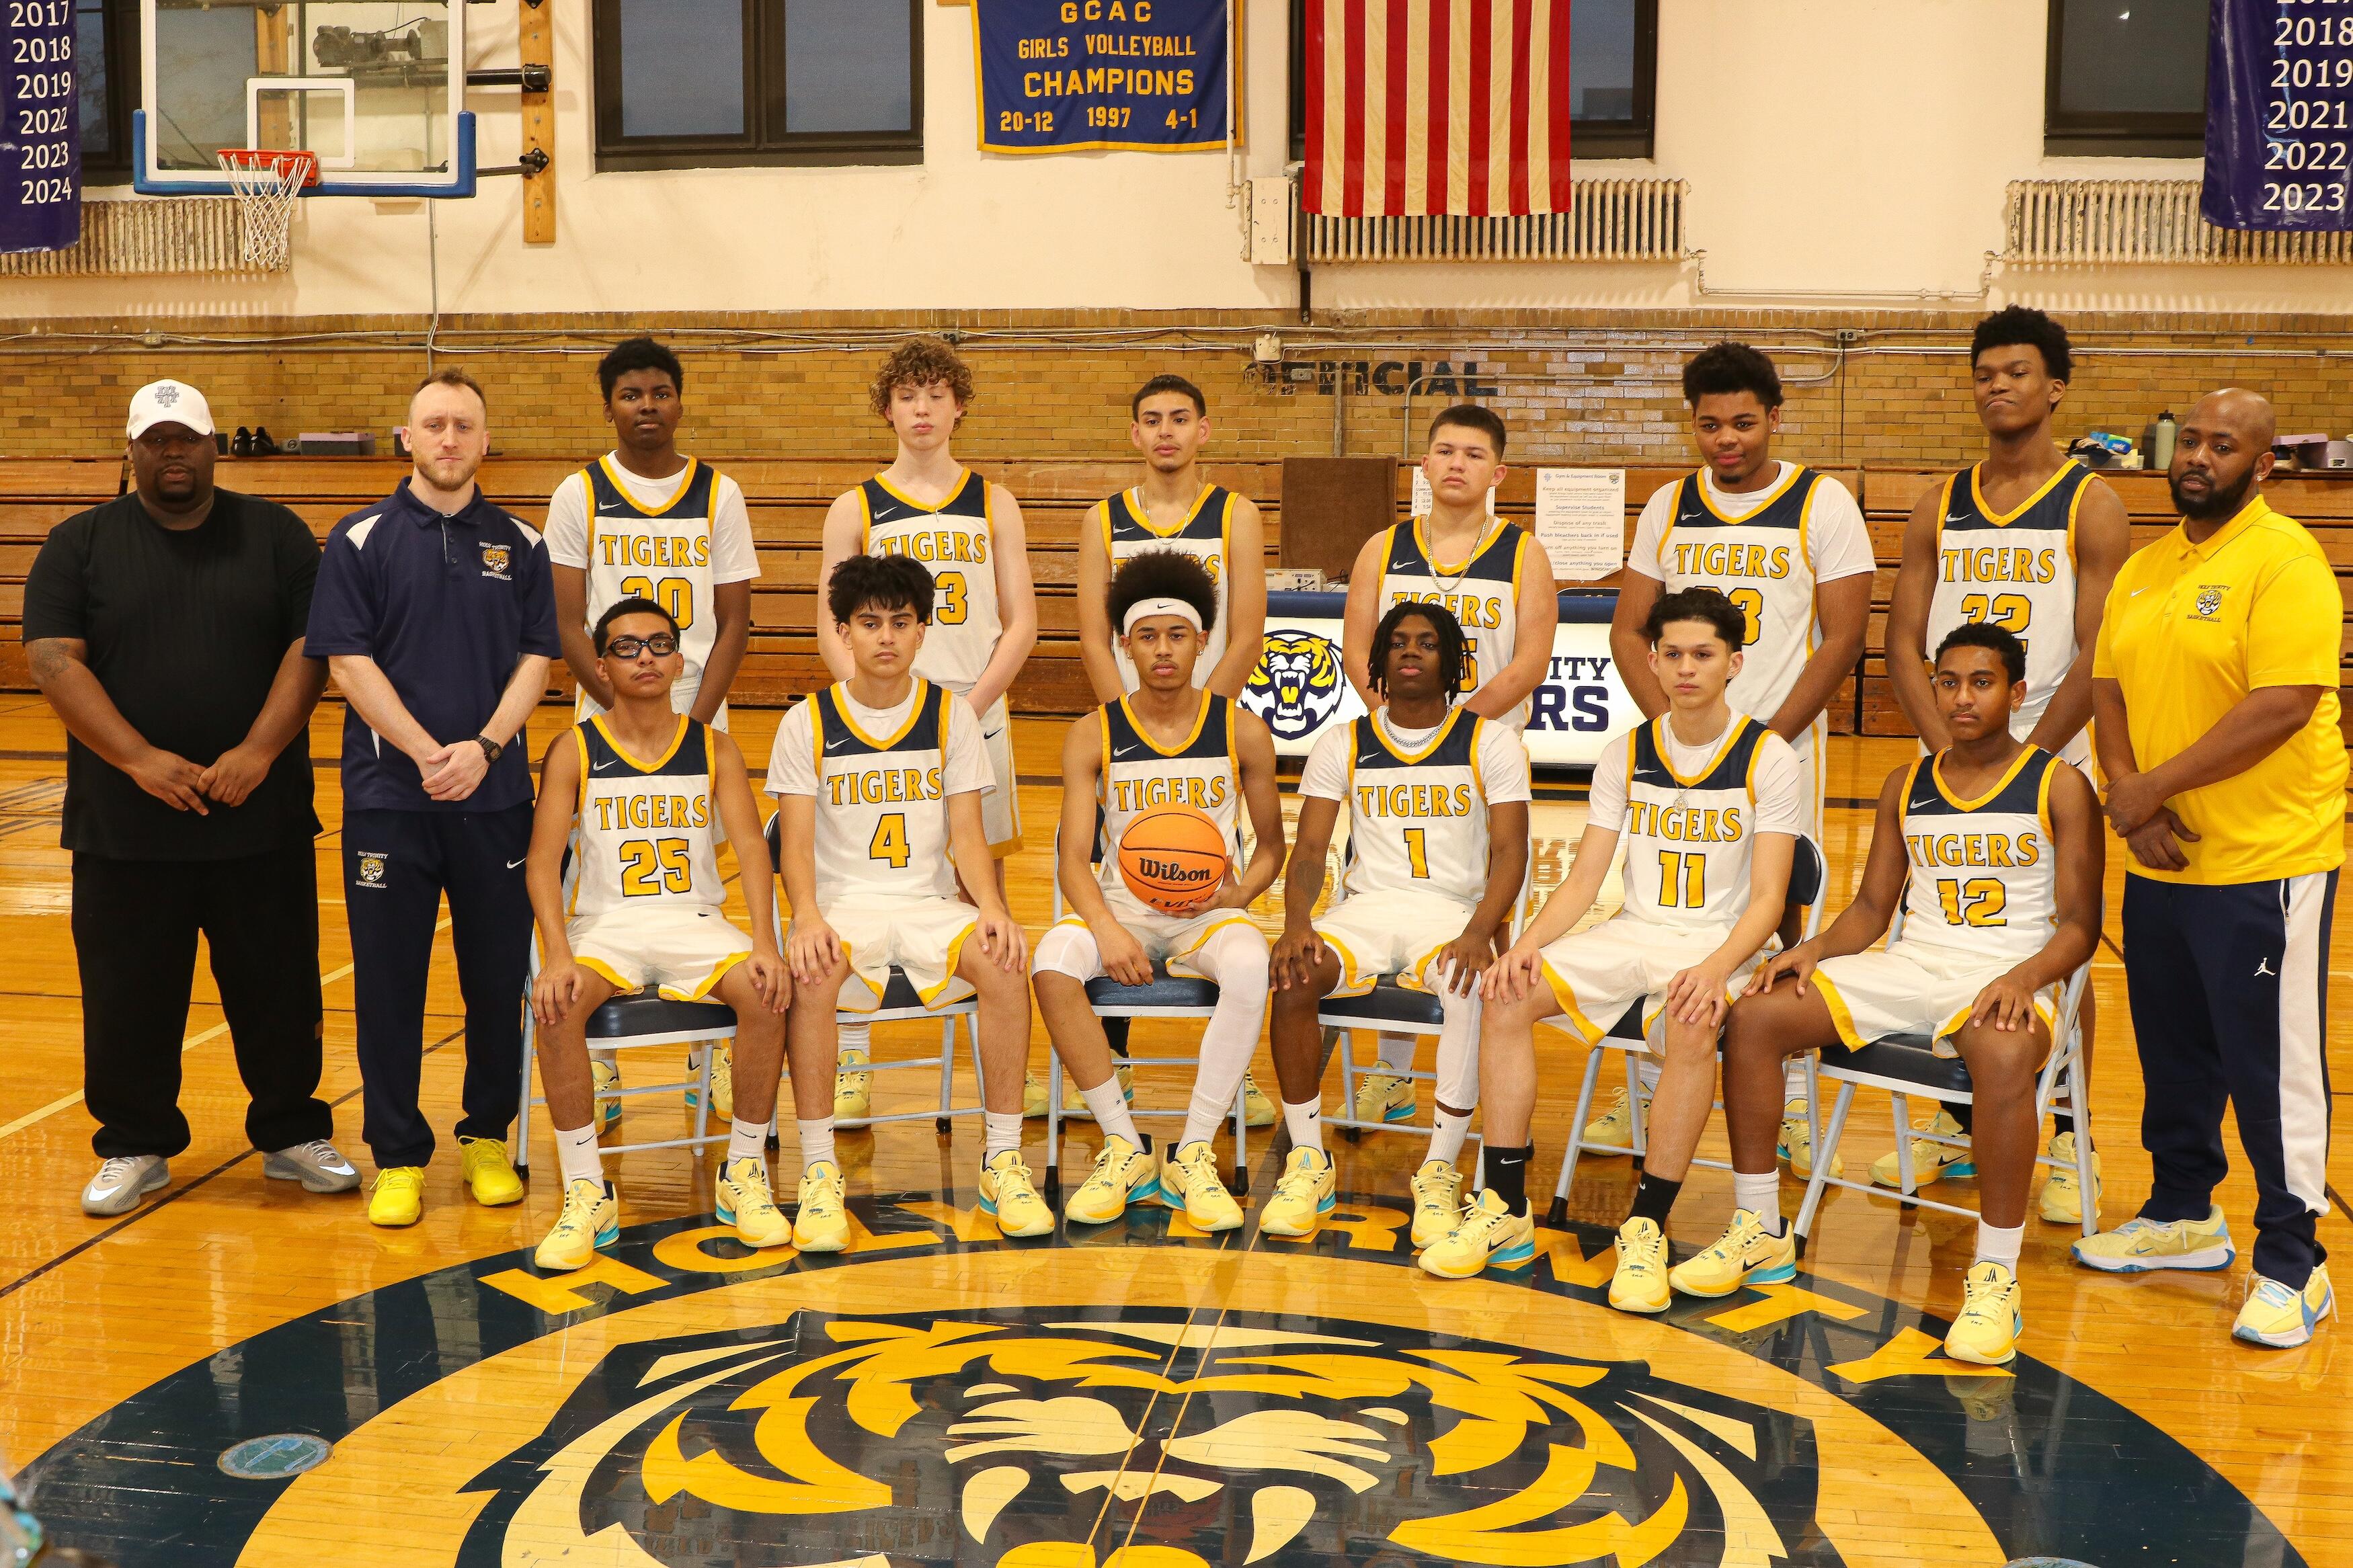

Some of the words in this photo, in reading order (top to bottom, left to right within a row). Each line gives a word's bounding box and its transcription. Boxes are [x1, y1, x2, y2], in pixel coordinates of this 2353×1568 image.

[9, 1, 69, 28] 2017
[1017, 36, 1069, 59] GIRLS
[1085, 34, 1197, 56] VOLLEYBALL
[2273, 17, 2353, 46] 2018
[12, 36, 71, 63] 2018
[15, 71, 72, 99] 2019
[1024, 68, 1195, 97] CHAMPIONS
[2270, 58, 2353, 88] 2019
[19, 106, 68, 135] 2022
[1000, 110, 1054, 132] 20-12
[1086, 106, 1131, 128] 1997
[1165, 108, 1197, 129] 4-1
[2267, 100, 2349, 130] 2021
[21, 140, 69, 170] 2023
[2264, 142, 2348, 171] 2022
[21, 176, 73, 205] 2024
[2263, 182, 2346, 212] 2023
[599, 534, 709, 567] TIGERS
[880, 531, 986, 564] TIGERS
[1673, 543, 1790, 579] TIGERS
[1940, 547, 2056, 584] TIGERS
[925, 571, 968, 626] 3
[1689, 585, 1763, 646] 3
[1549, 657, 1611, 681] ITY
[1525, 685, 1609, 732] RS
[826, 768, 942, 806] TIGERS
[1114, 776, 1226, 812] TIGERS
[1357, 784, 1471, 818] TIGERS
[594, 794, 709, 831] TIGERS
[1629, 800, 1743, 842] TIGERS
[869, 813, 910, 868] 4
[1403, 827, 1430, 878] 1
[1906, 832, 2039, 868] TIGERS
[619, 837, 692, 897] 25
[1140, 857, 1211, 882] Wilson
[1658, 850, 1706, 909] 11
[1936, 877, 2007, 928] 12
